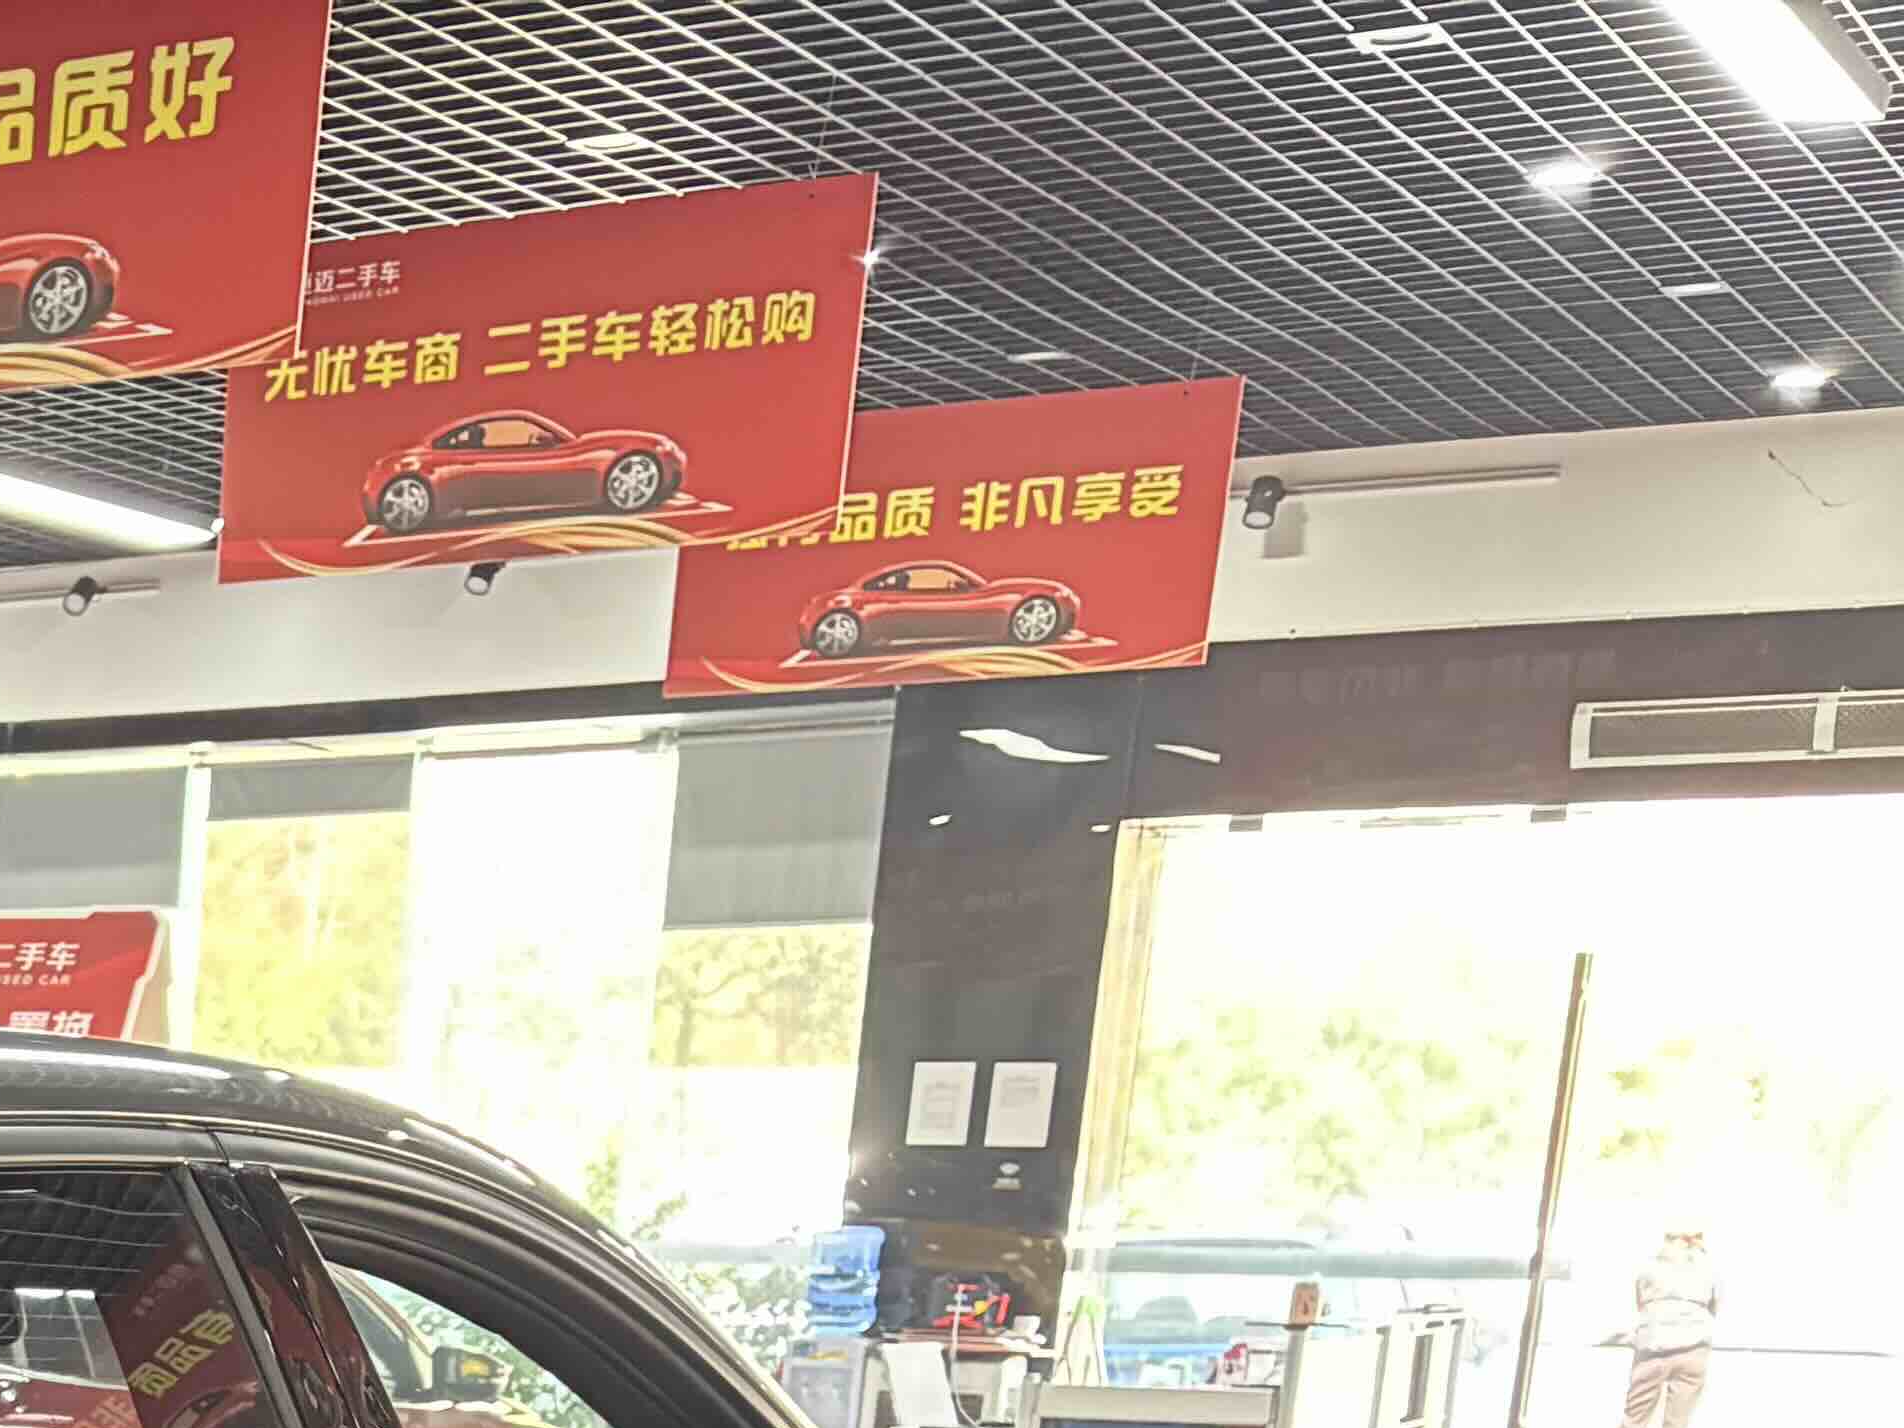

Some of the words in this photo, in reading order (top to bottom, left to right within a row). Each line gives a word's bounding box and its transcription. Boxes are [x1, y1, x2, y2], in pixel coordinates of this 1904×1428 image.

[265, 331, 462, 402] 无忧车商
[483, 289, 816, 377] 二手车轻松购
[959, 464, 1184, 533] 非凡享受
